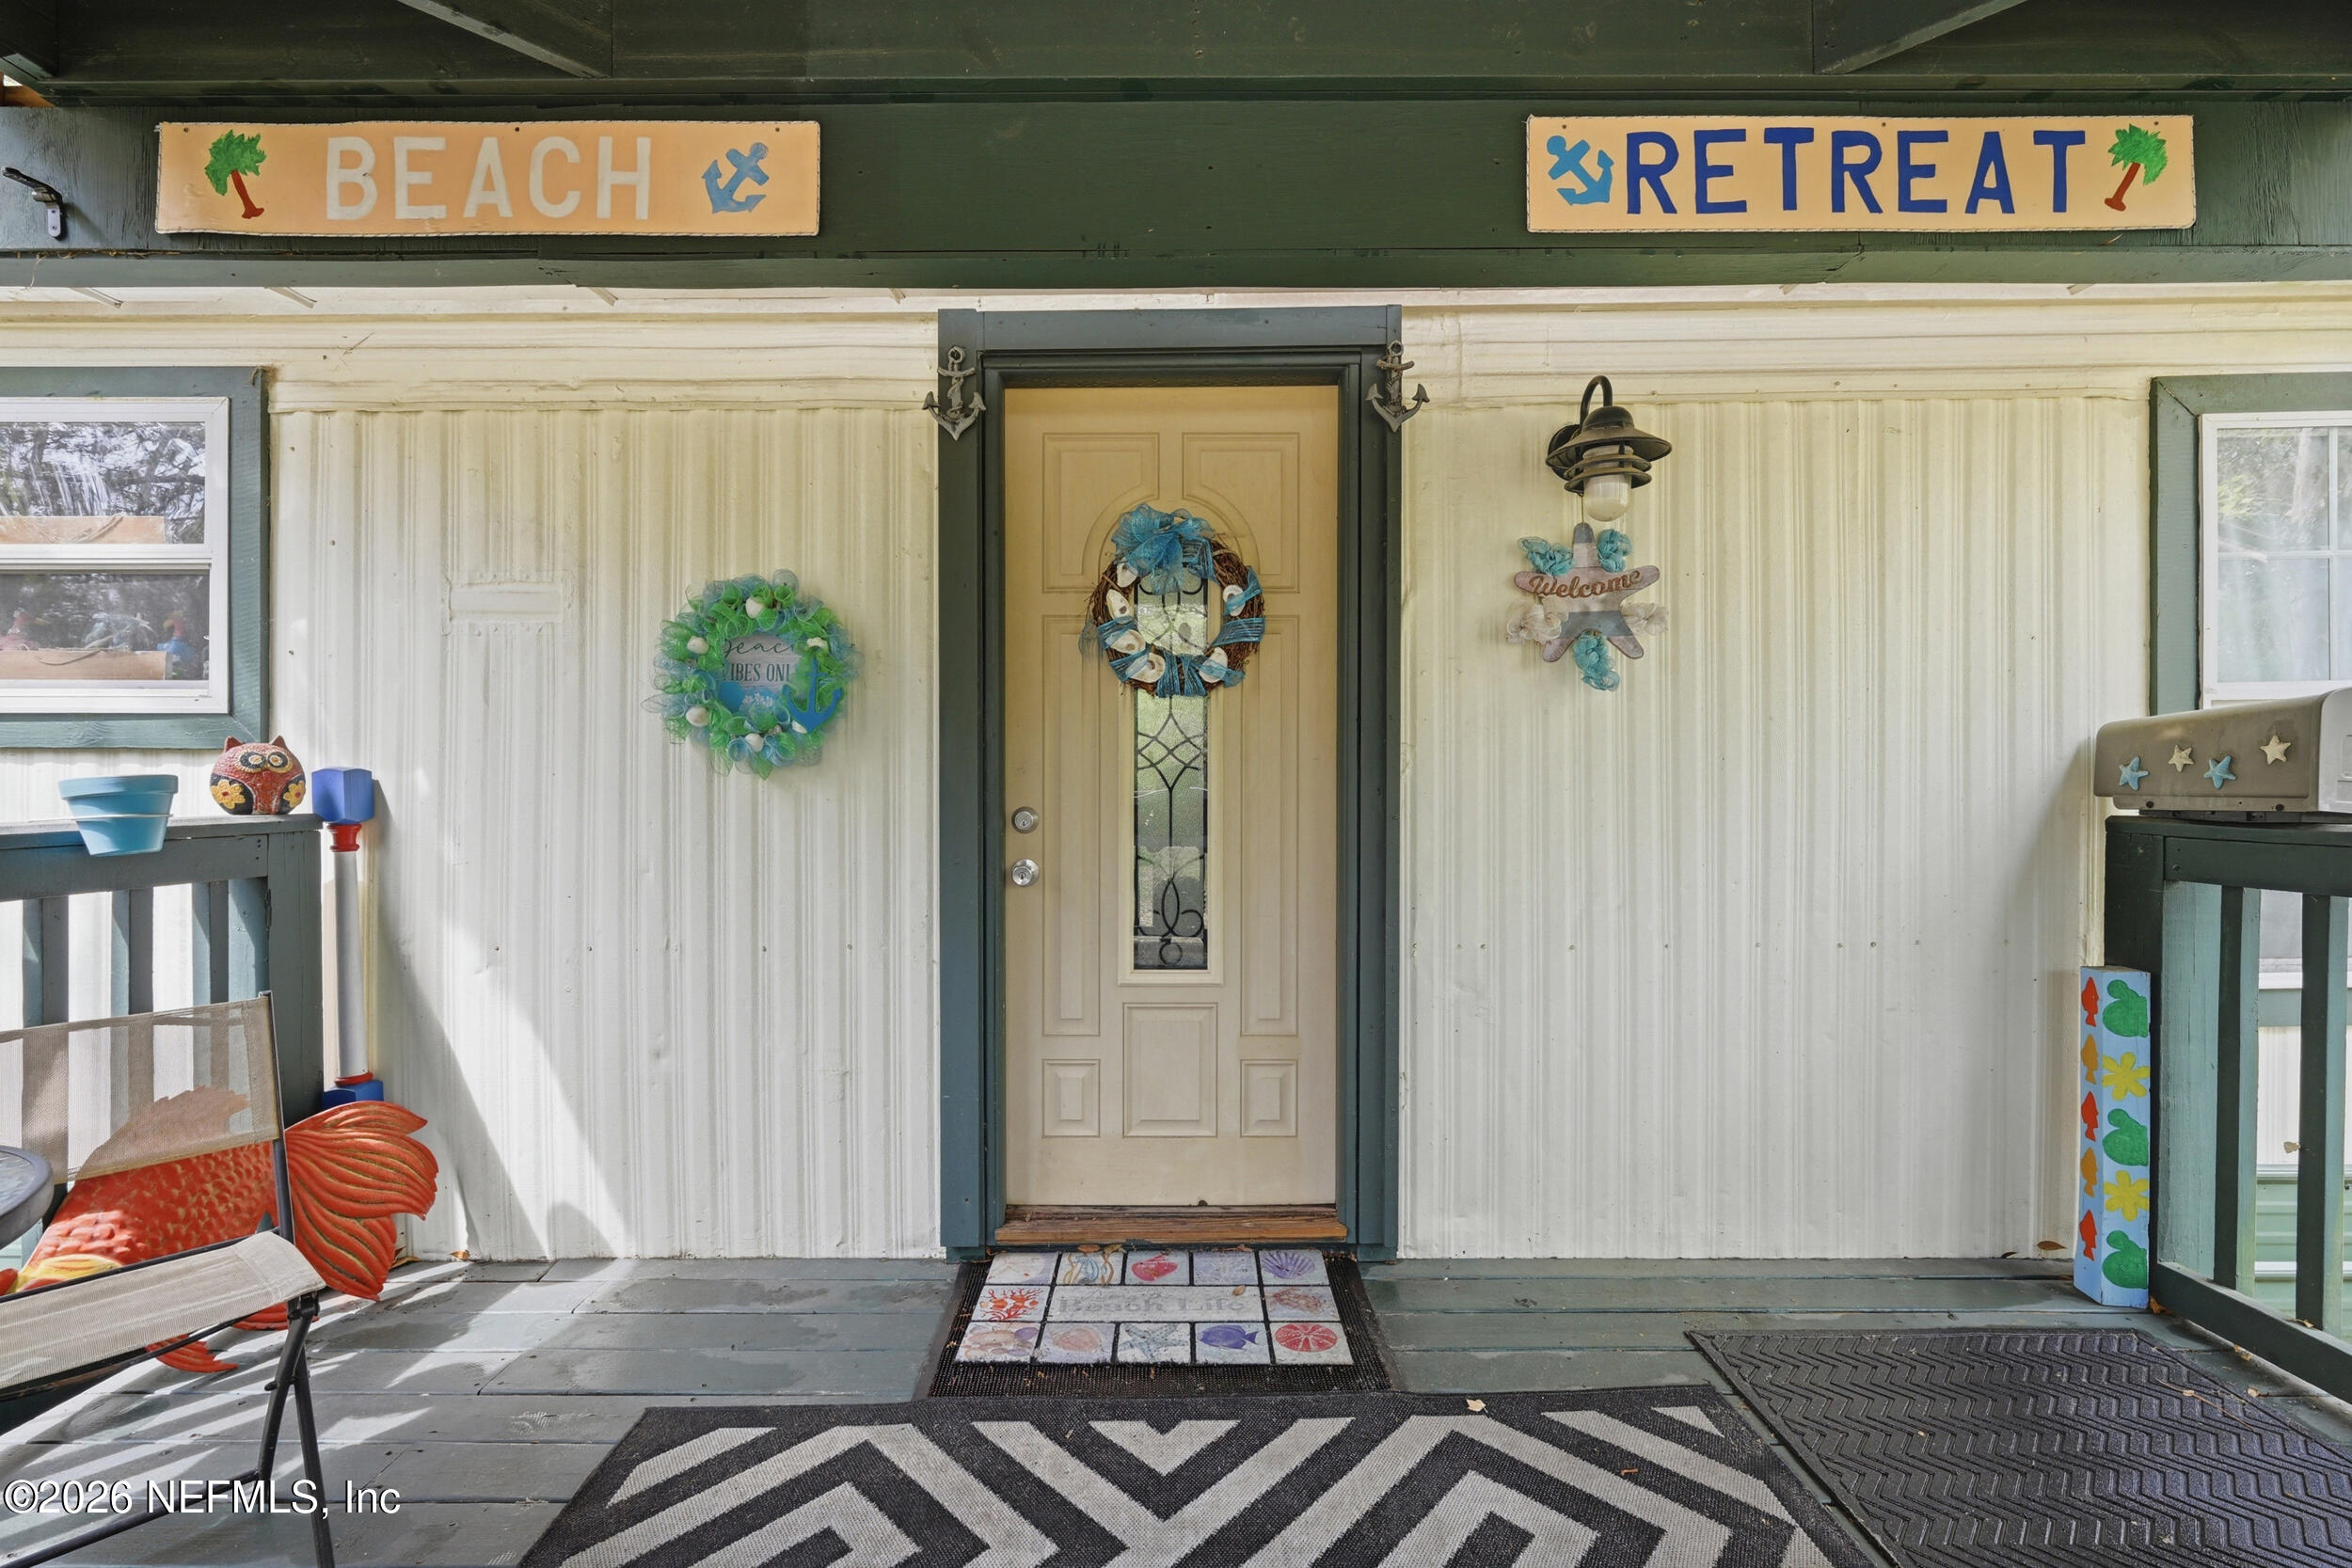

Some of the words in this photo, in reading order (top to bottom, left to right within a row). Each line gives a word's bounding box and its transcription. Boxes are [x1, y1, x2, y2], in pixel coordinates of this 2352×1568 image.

[326, 135, 652, 221] BEACH
[1626, 127, 2086, 215] RETREAT
[1529, 570, 1641, 599] Welcome
[723, 663, 761, 682] IBES
